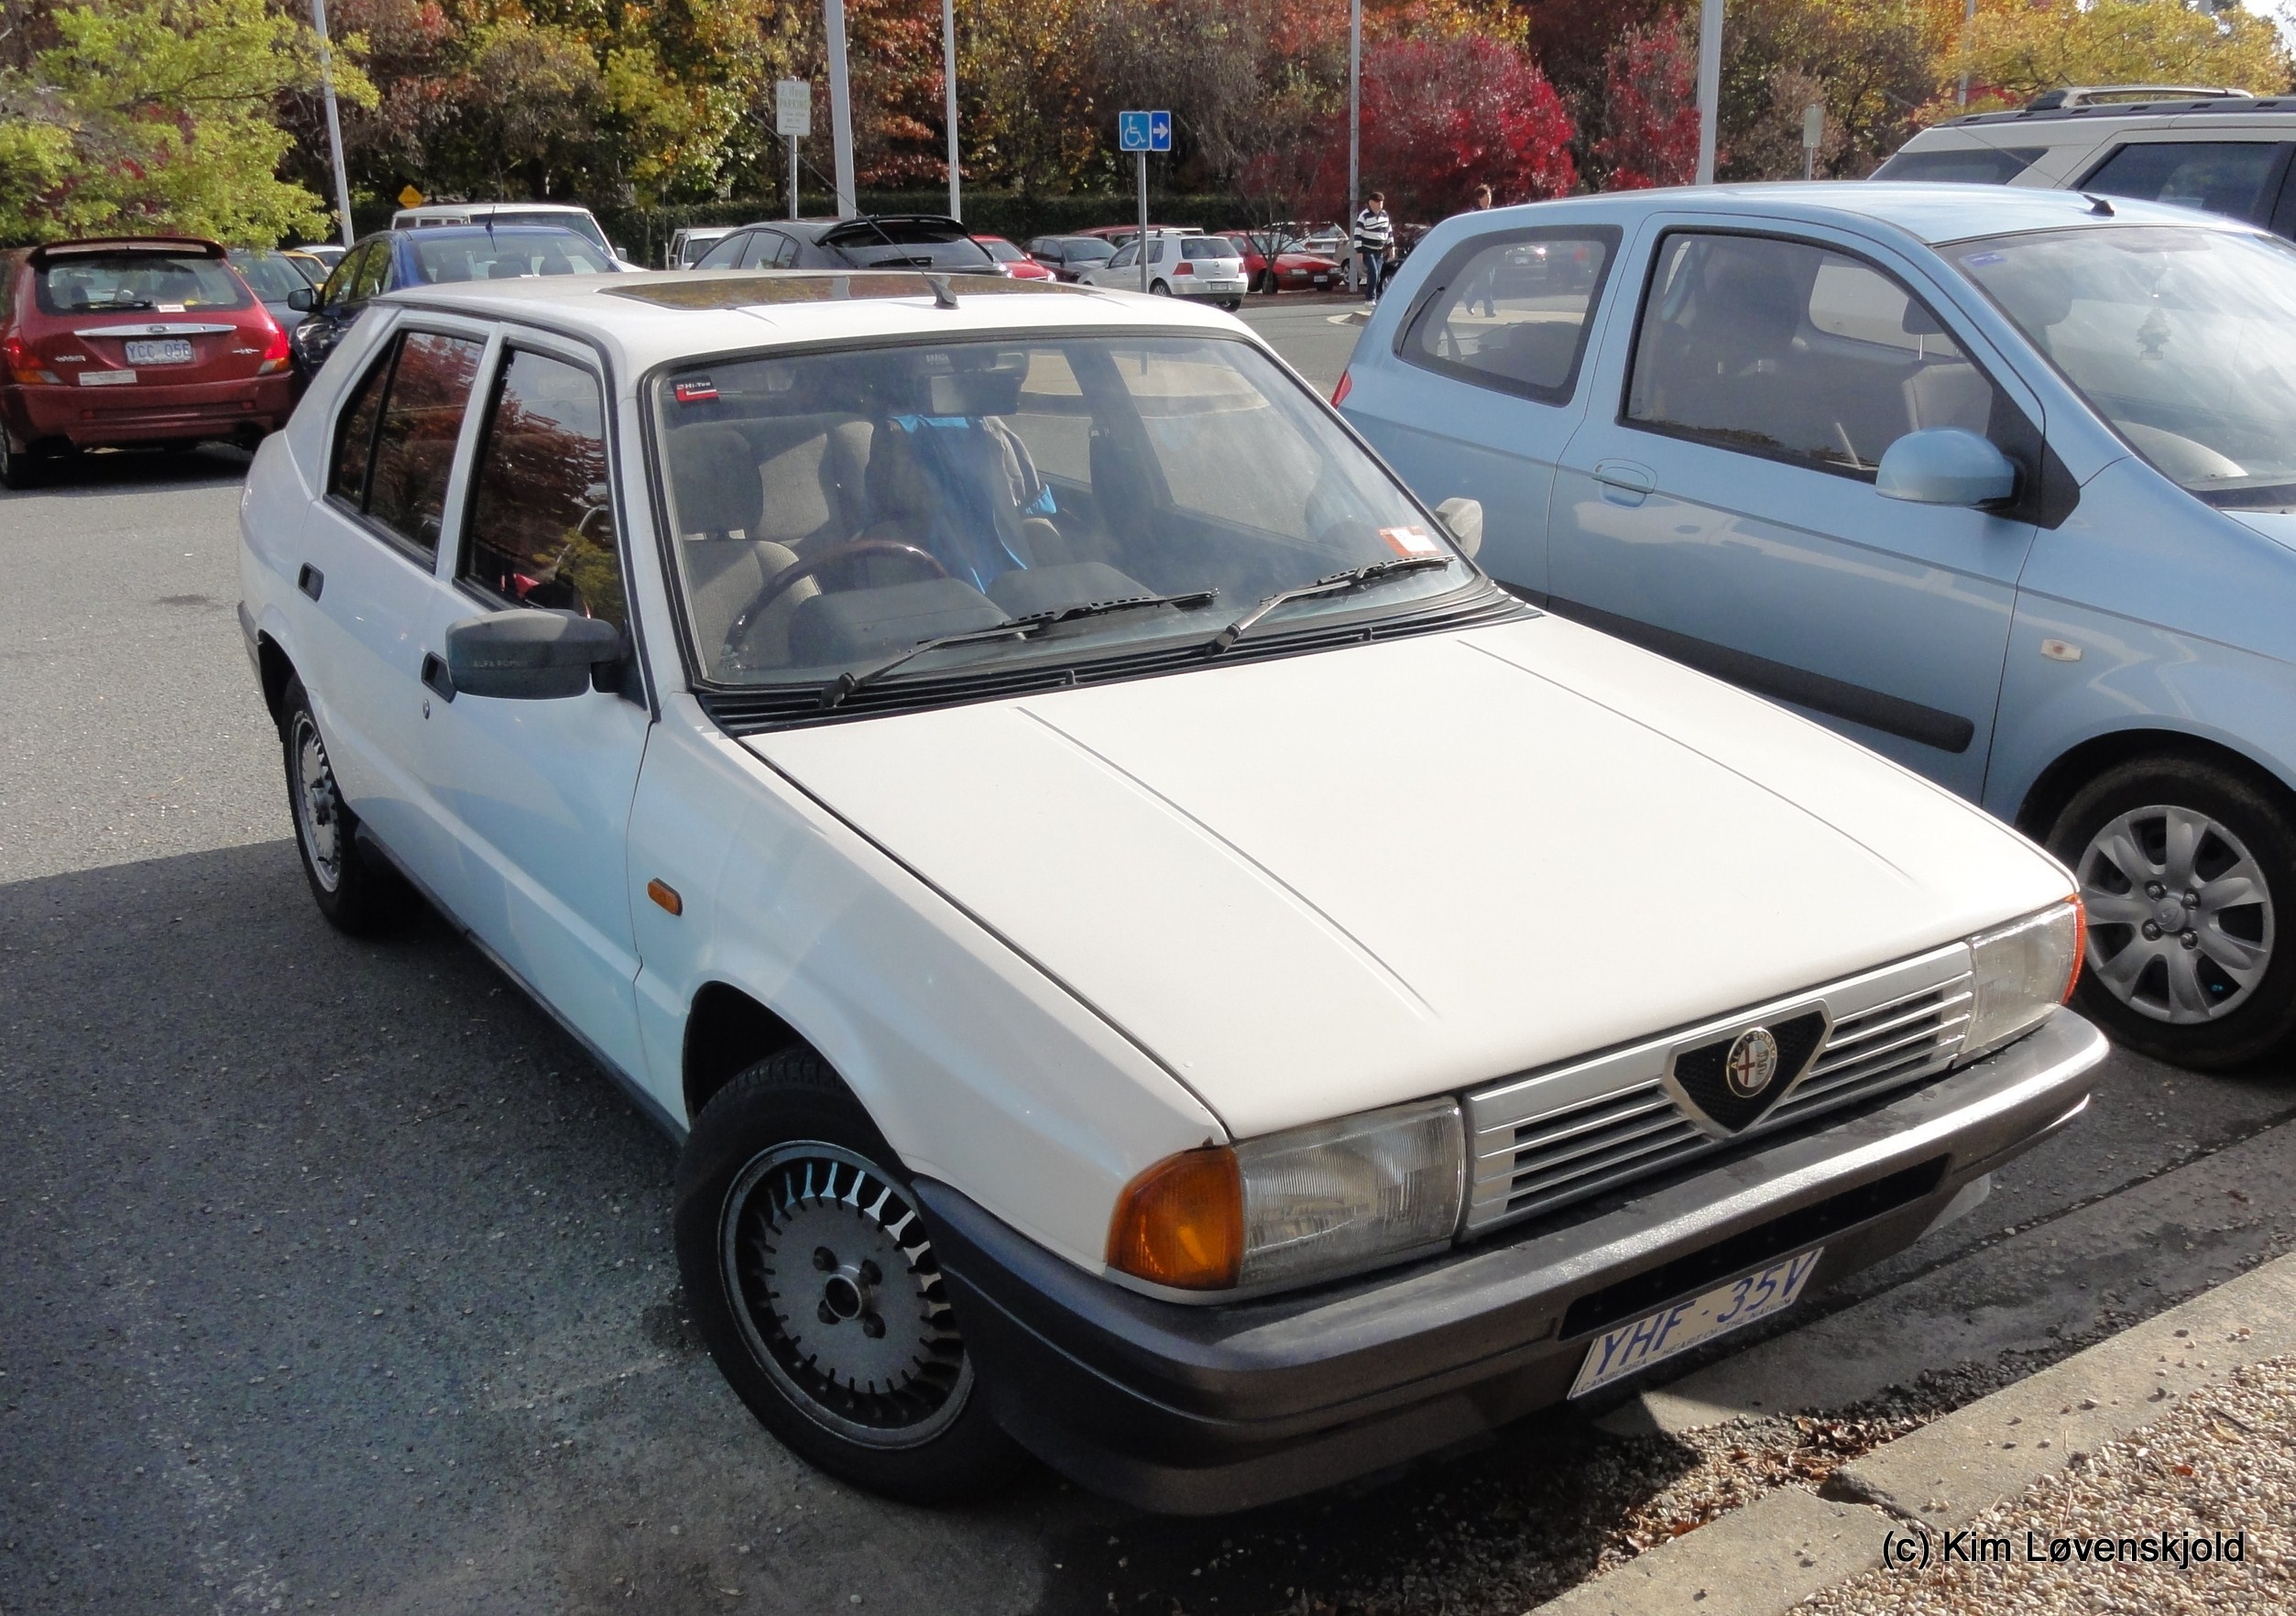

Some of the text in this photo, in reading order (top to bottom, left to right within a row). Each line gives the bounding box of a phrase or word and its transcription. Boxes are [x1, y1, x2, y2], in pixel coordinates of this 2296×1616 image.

[126, 344, 154, 359] YCC
[1595, 1249, 1820, 1377] YHF 35V
[1580, 1358, 1649, 1392] CANBERRA
